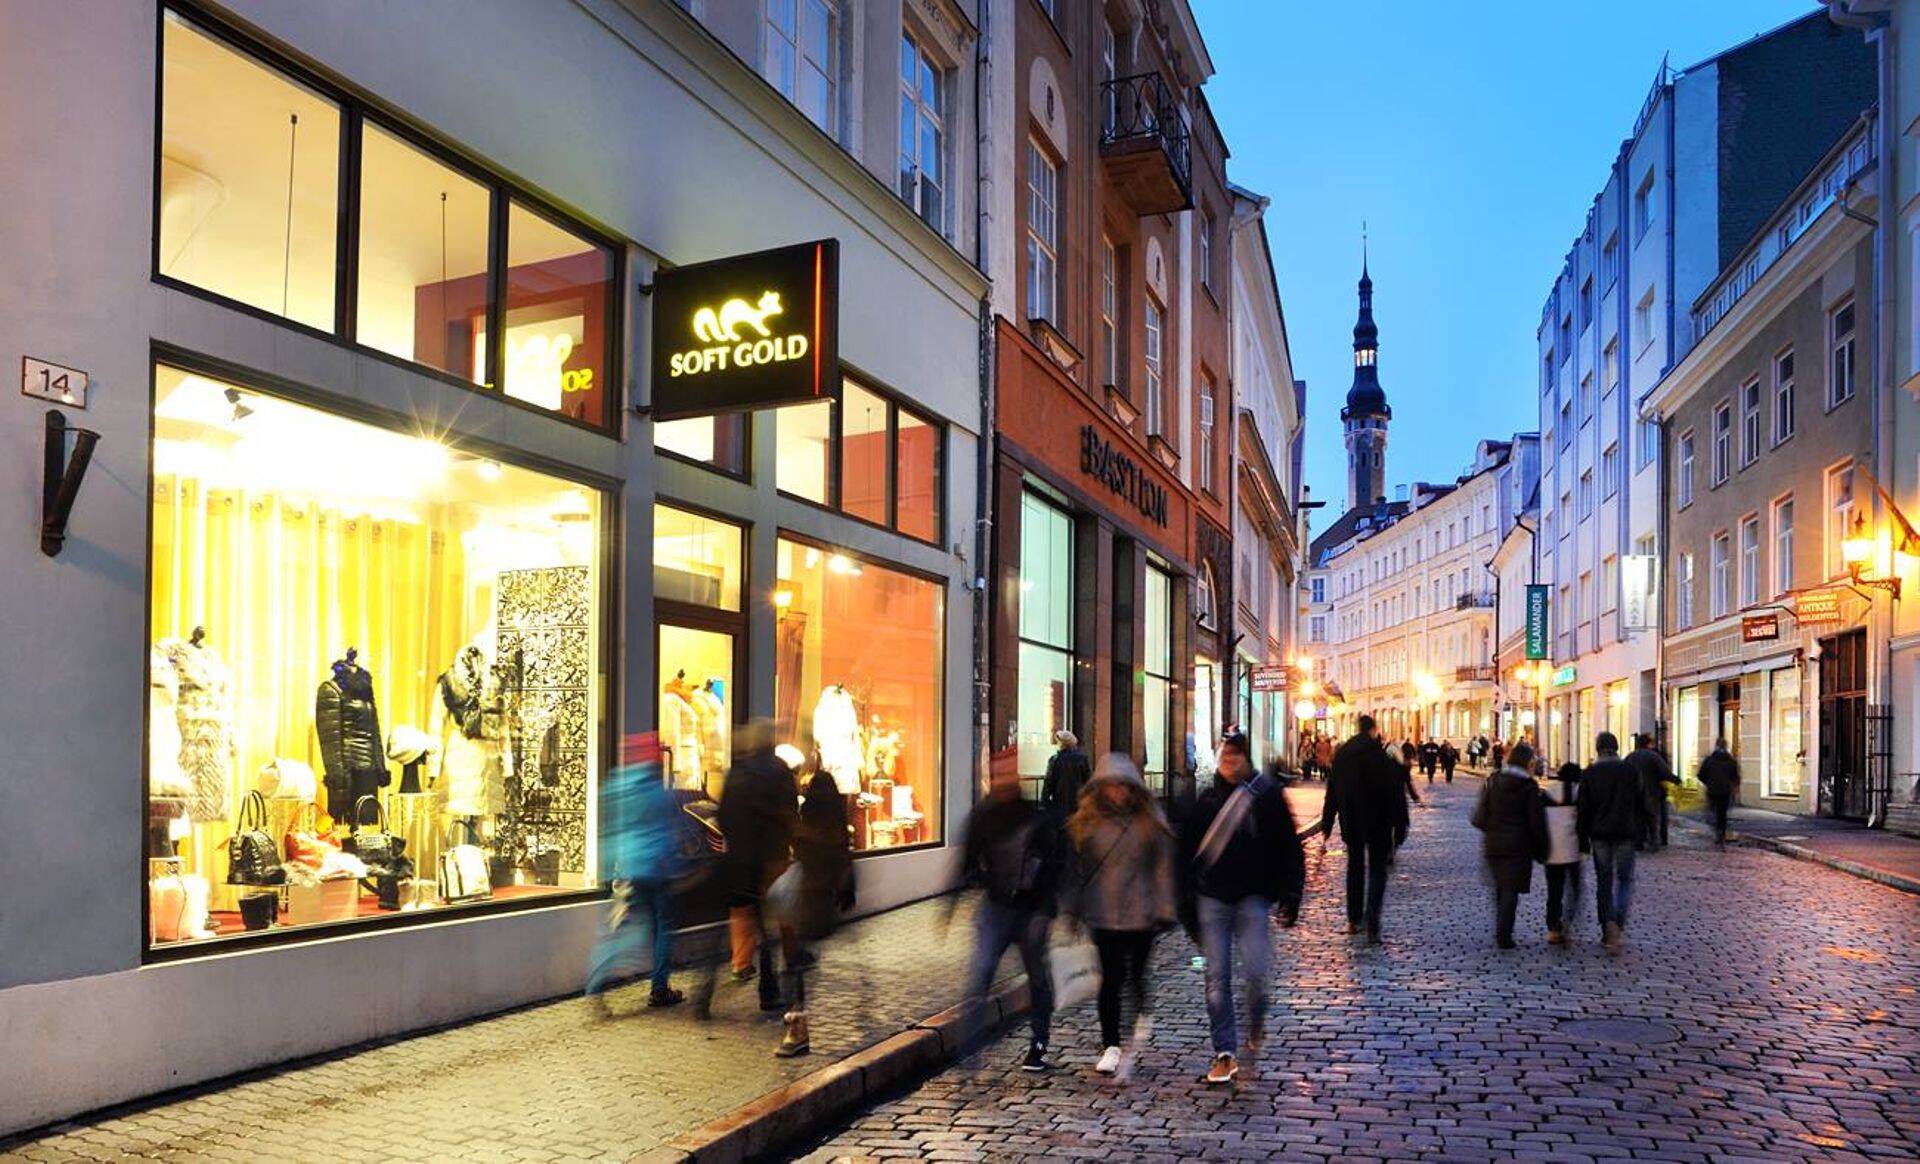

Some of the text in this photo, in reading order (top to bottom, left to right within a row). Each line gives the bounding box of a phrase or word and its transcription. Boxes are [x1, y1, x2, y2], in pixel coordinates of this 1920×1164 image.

[670, 334, 809, 378] SOFT GOLD
[39, 368, 70, 396] 14
[1080, 424, 1169, 529] BASTION
[1532, 592, 1543, 653] SALAMANDER
[1798, 601, 1836, 613] ANTIQUE
